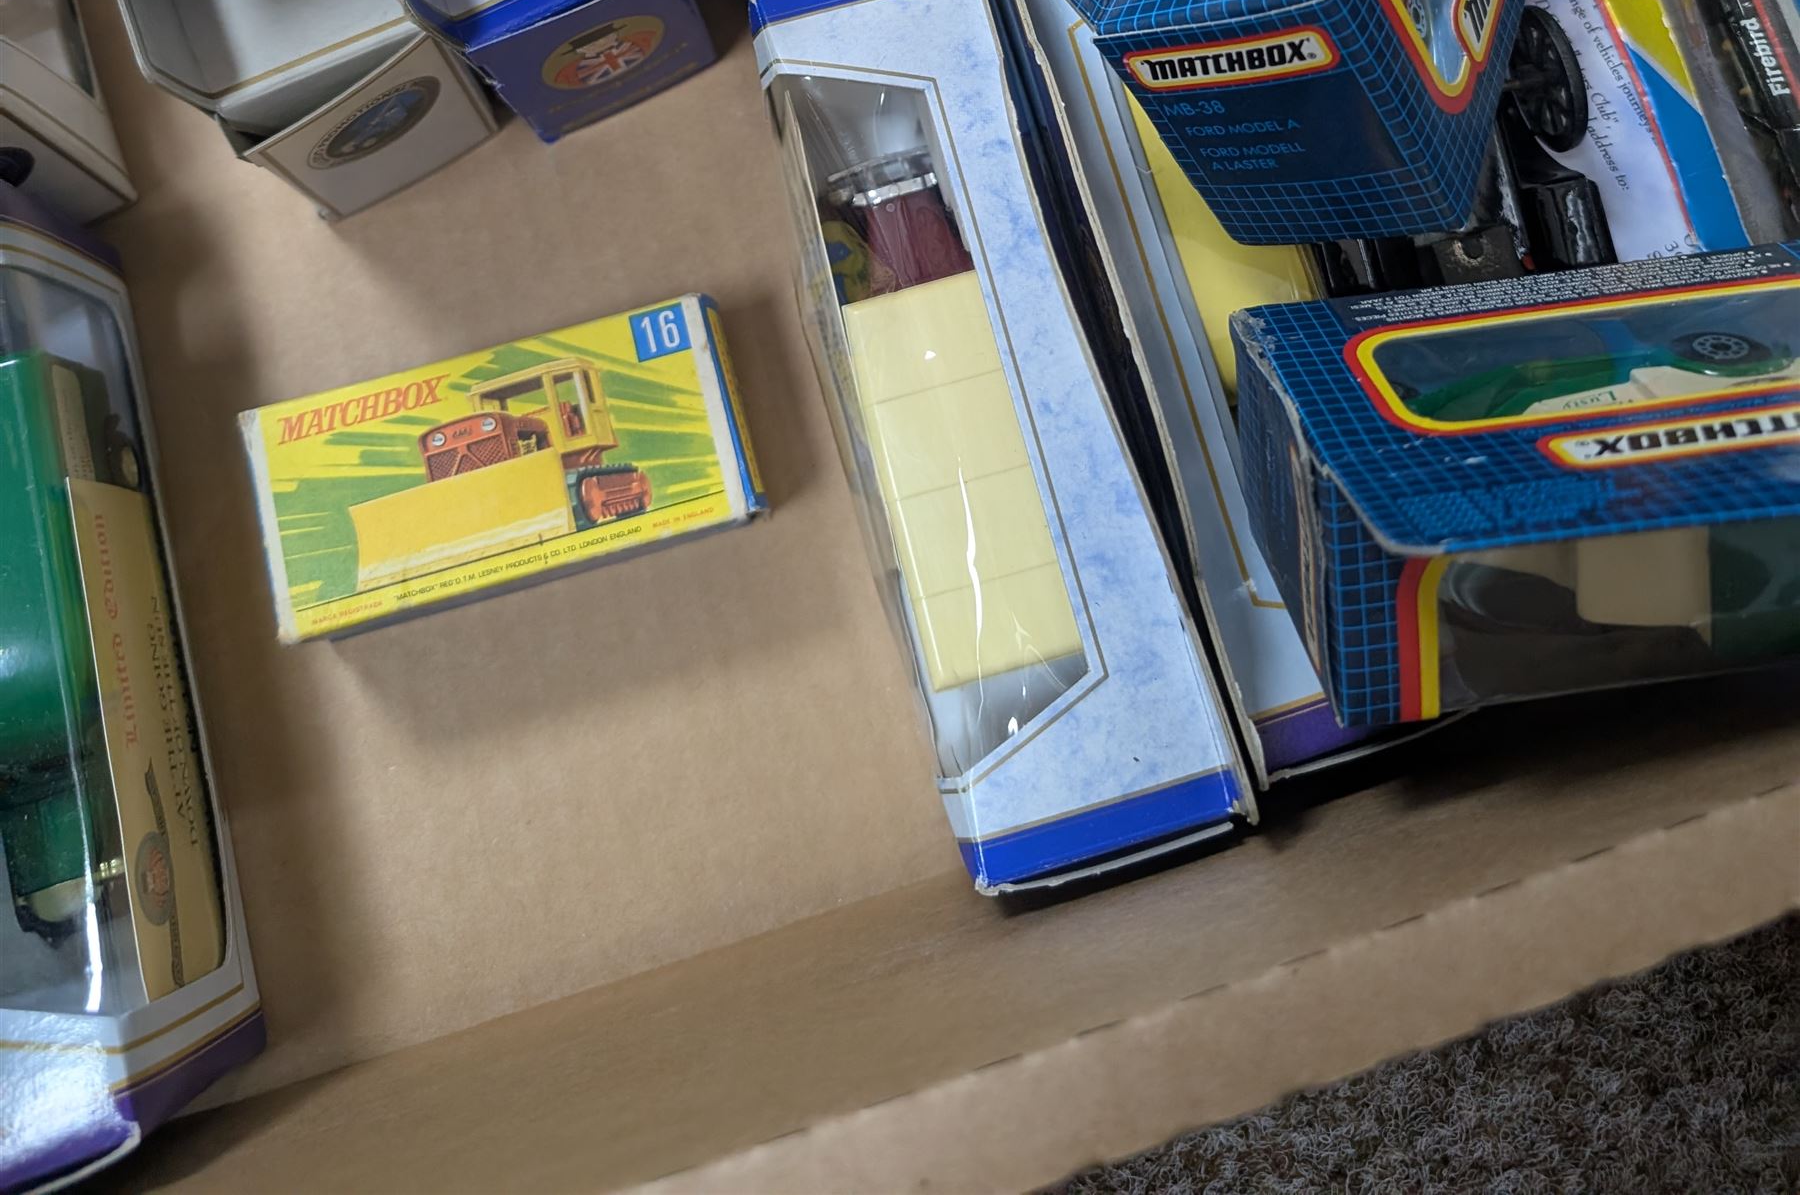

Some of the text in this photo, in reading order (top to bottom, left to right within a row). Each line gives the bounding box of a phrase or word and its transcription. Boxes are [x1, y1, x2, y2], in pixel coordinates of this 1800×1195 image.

[1141, 37, 1317, 81] MATCHBOX
[1582, 16, 1602, 35] of
[1592, 32, 1628, 82] vehicles
[1749, 17, 1791, 99] Firebird
[1163, 100, 1225, 118] MB-38
[1184, 119, 1301, 137] FORD MODEL A
[1200, 142, 1306, 158] FORD MODELL
[1212, 158, 1279, 171] A LASTER
[1614, 172, 1631, 192] to:
[639, 310, 682, 354] 16
[277, 373, 449, 445] MATCHBOX
[477, 565, 503, 577] LESNEY
[504, 553, 542, 570] PRODUCTS
[578, 535, 608, 549] LONDON
[609, 525, 642, 540] ENGLAND
[682, 506, 714, 520] ENGLAND
